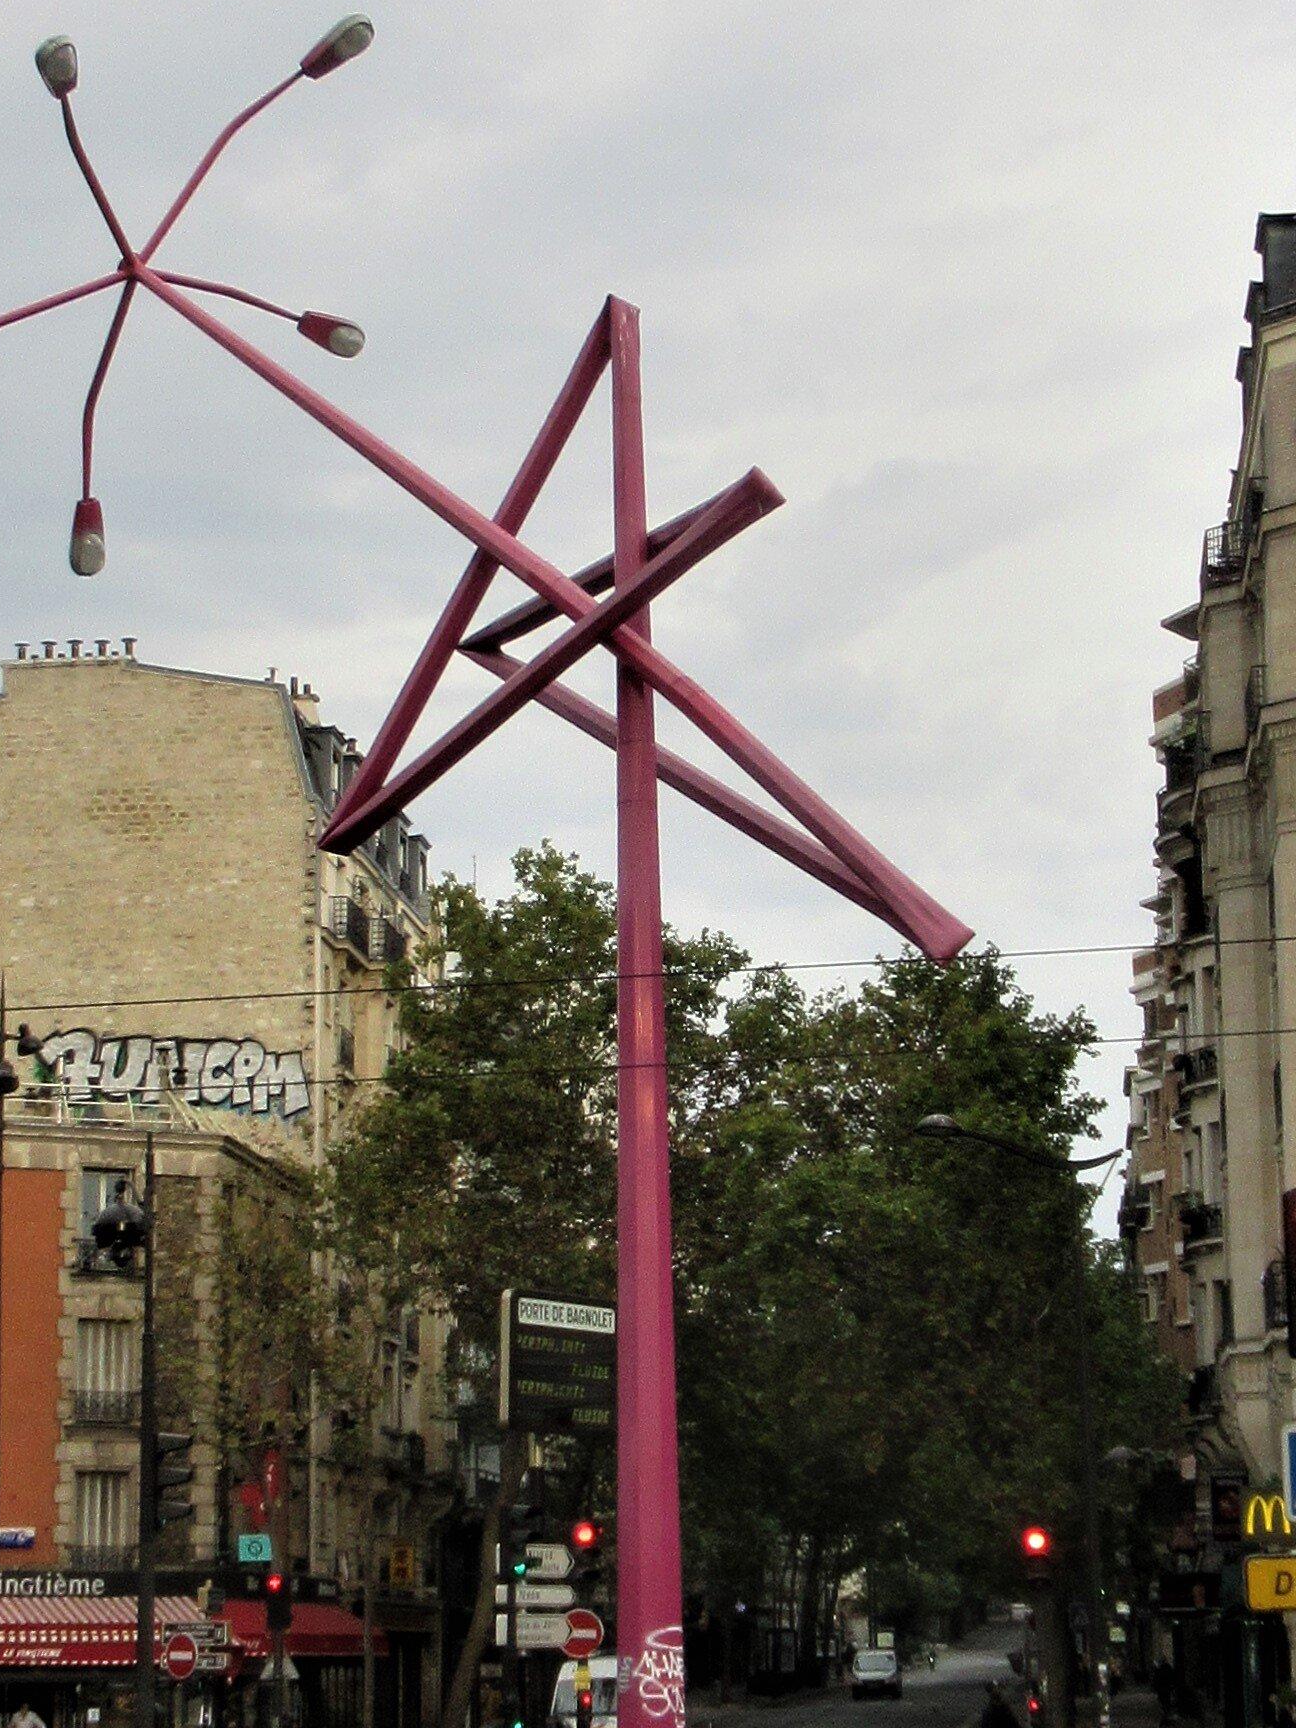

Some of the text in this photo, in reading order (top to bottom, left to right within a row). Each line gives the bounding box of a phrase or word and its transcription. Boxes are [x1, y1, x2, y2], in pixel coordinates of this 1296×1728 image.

[520, 1301, 614, 1329] PORTE DE BAGNOLET
